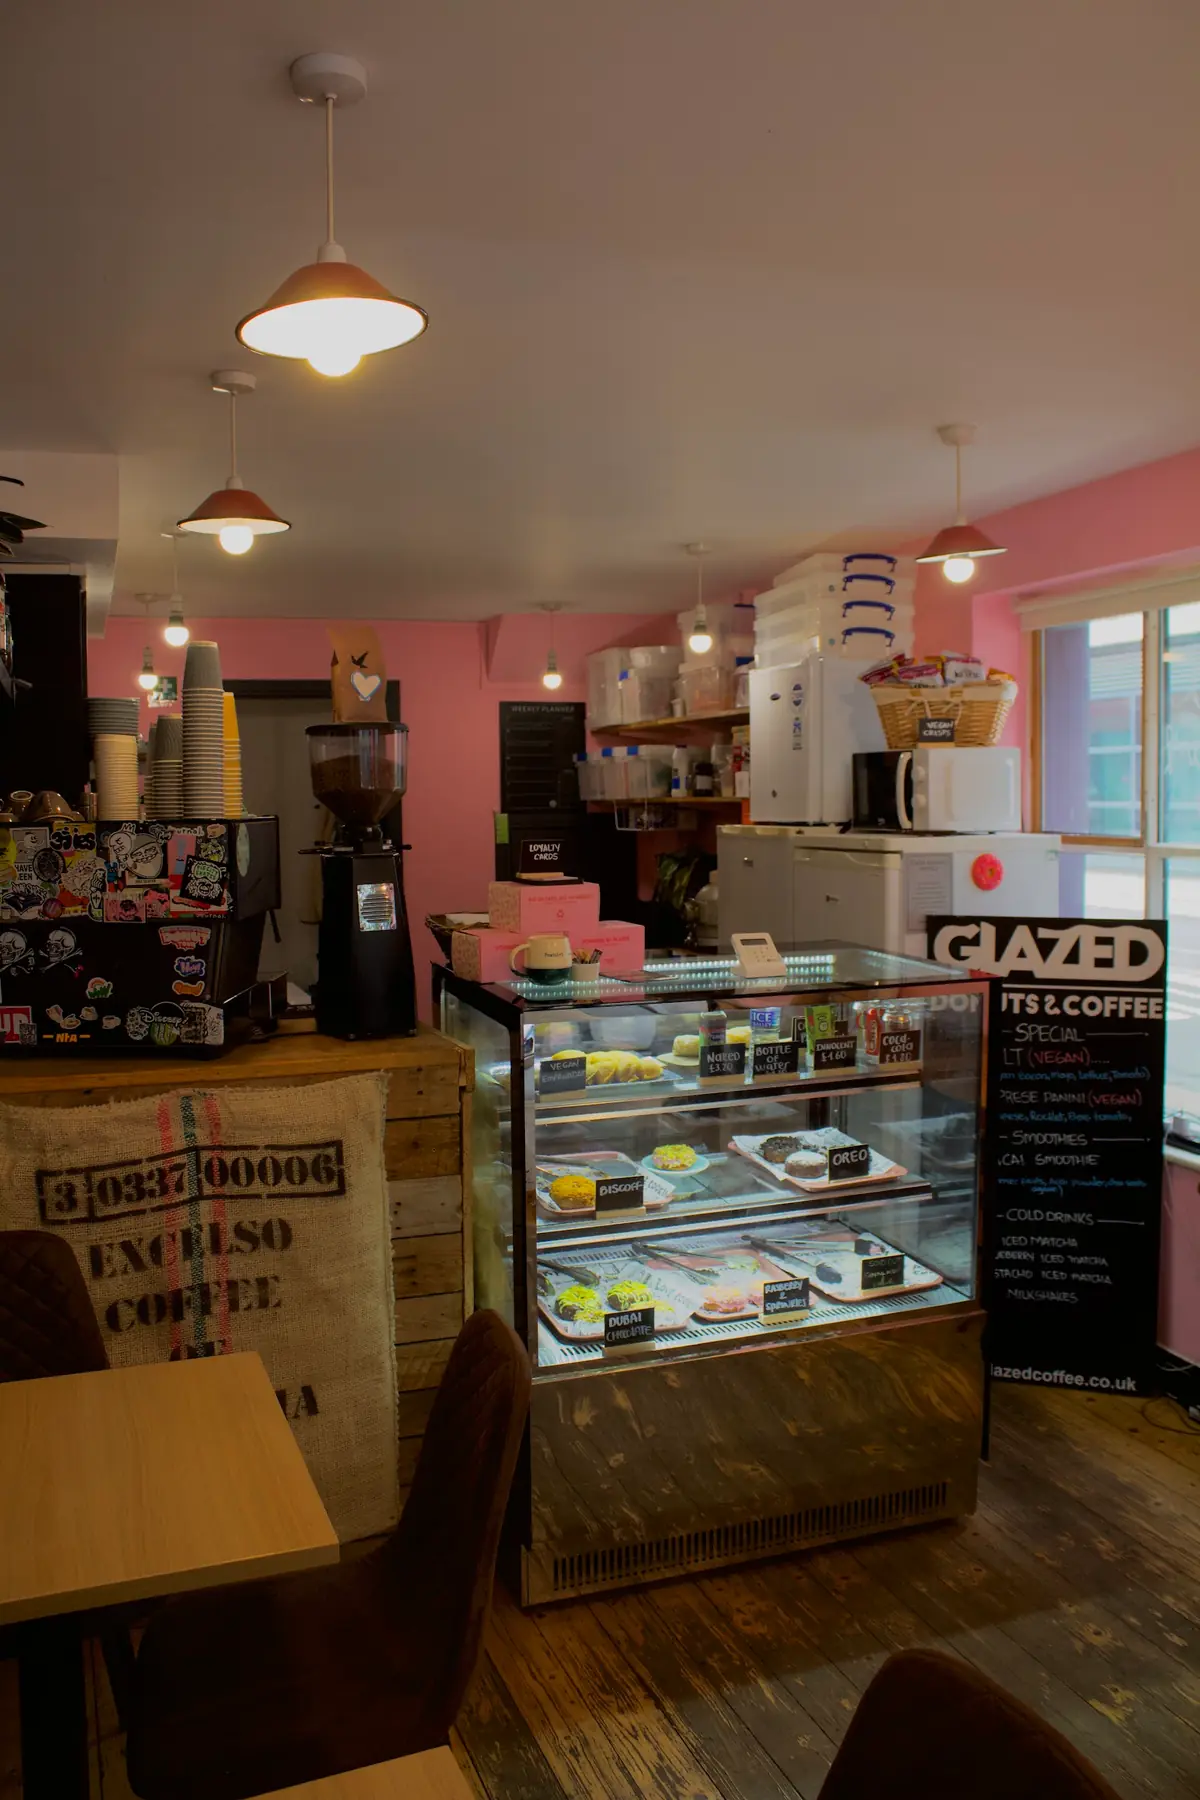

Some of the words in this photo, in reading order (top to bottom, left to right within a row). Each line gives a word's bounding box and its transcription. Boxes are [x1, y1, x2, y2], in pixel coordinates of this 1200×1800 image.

[529, 843, 561, 853] LOYALTY
[534, 852, 559, 861] CARDS
[18, 873, 33, 881] EEN
[933, 920, 1165, 982] GLAZED
[1043, 994, 1061, 1016] &
[1062, 995, 1164, 1019] COFFEE
[752, 1011, 772, 1022] ICE
[1014, 1022, 1086, 1043] SPECIAL
[755, 1044, 792, 1056] BOTTLE
[766, 1054, 780, 1064] OF
[832, 1148, 869, 1166] OREO
[55, 1182, 77, 1212] 3
[98, 1161, 187, 1206] 0337
[204, 1153, 336, 1188] 00006
[599, 1180, 645, 1197] BISCOFF
[1006, 1208, 1044, 1222] COLD
[1045, 1210, 1095, 1226] DRINKS
[1001, 1235, 1028, 1247] ICED
[1030, 1236, 1079, 1249] MATCHA
[105, 1275, 282, 1332] COFFEE
[608, 1311, 643, 1328] DUBAI
